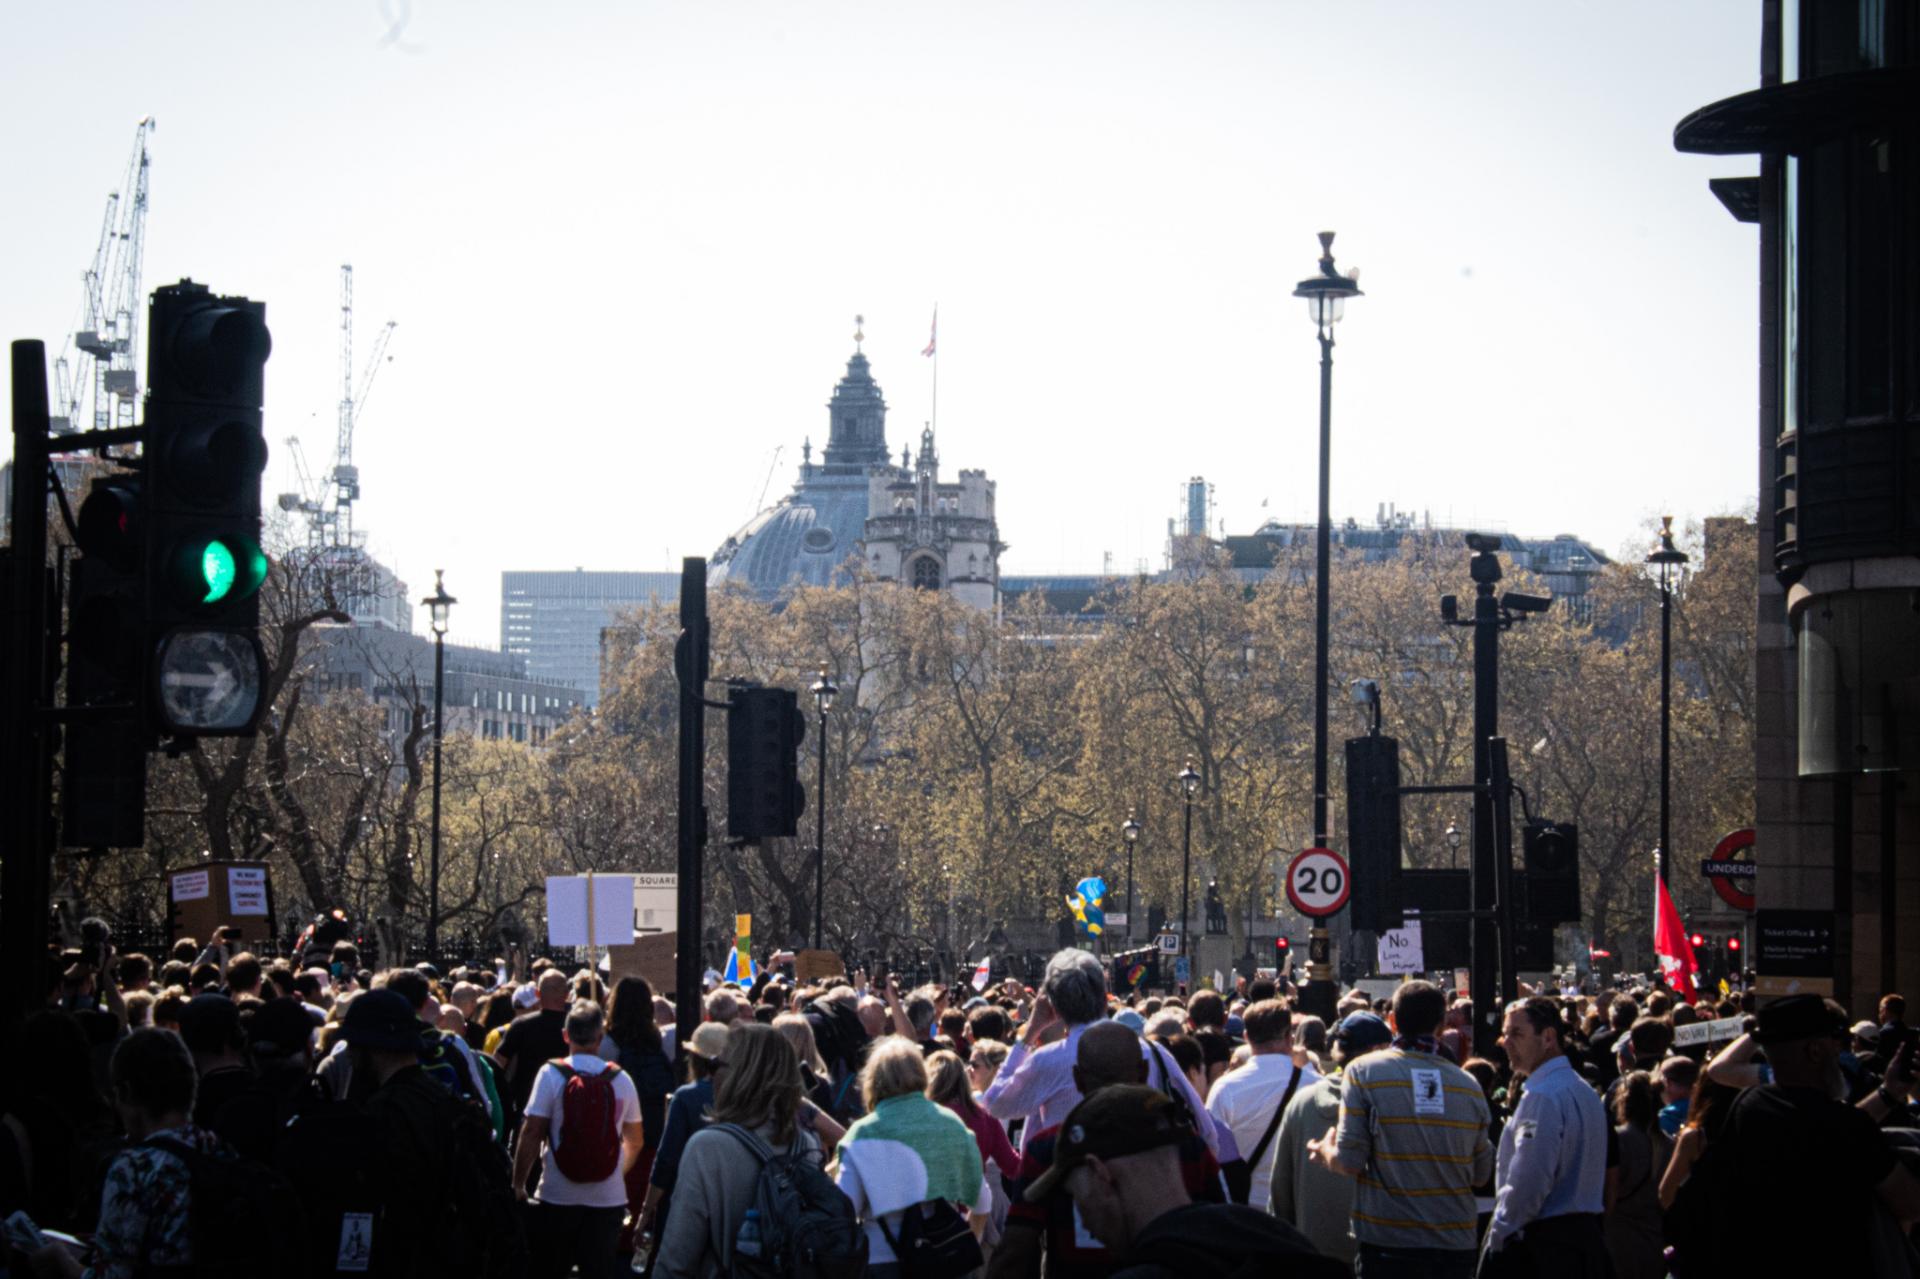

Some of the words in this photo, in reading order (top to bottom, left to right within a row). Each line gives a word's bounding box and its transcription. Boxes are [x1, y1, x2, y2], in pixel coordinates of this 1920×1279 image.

[640, 877, 676, 885] SQUARE
[1297, 867, 1342, 895] 20
[1763, 929, 1785, 937] Ticket
[1786, 929, 1808, 937] Office
[1389, 933, 1408, 948] No
